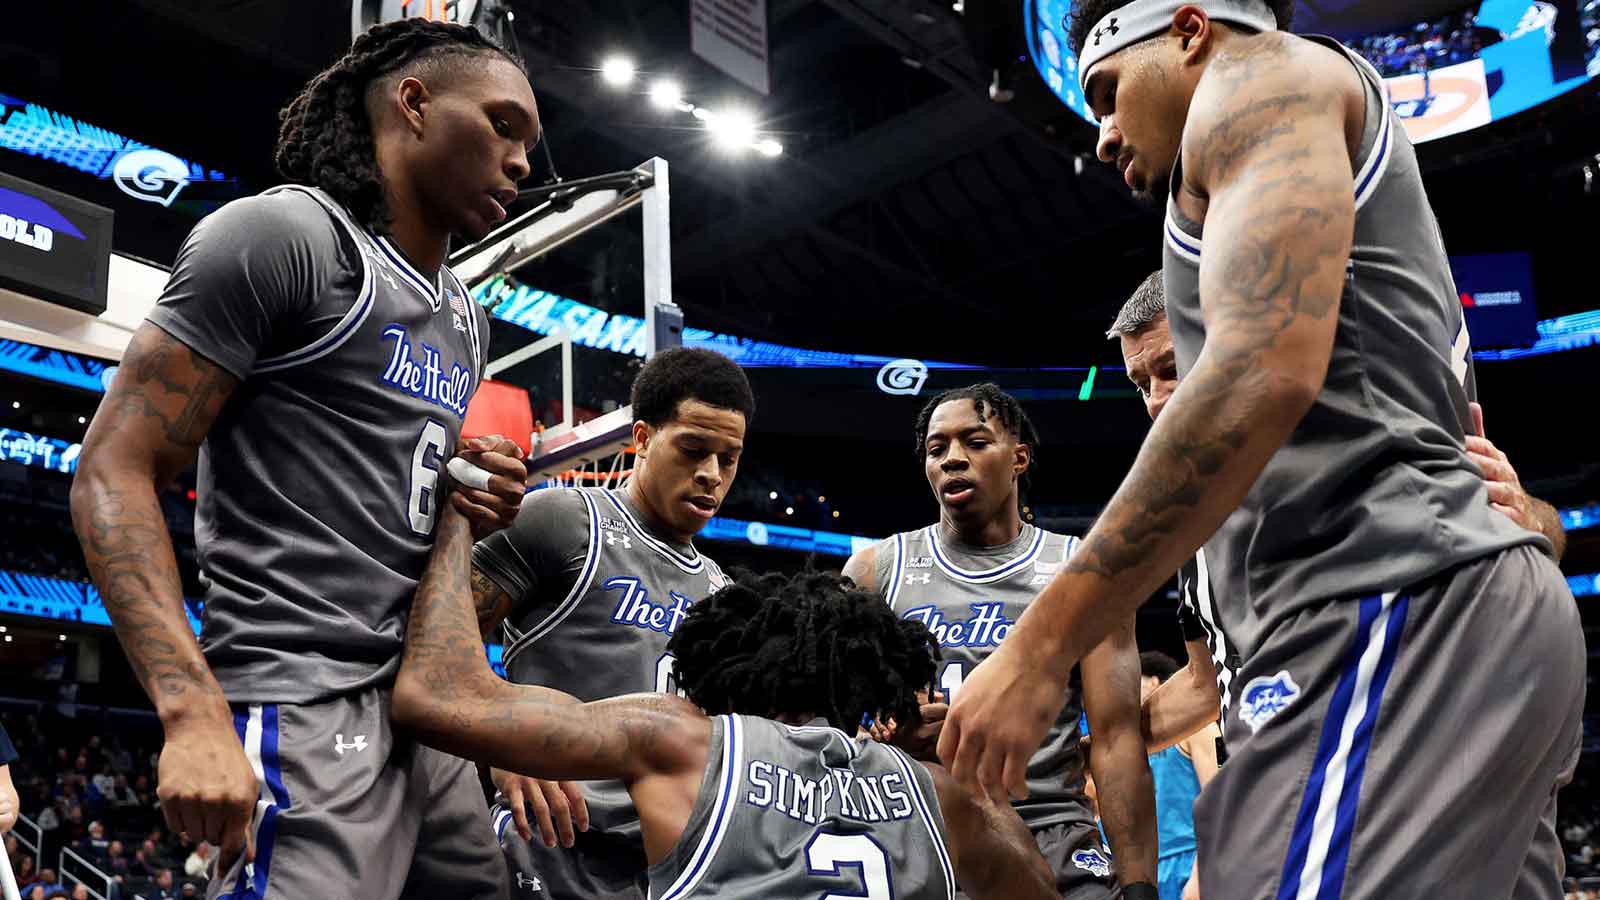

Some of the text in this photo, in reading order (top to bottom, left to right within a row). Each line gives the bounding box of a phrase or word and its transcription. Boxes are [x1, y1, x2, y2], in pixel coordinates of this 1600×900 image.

[0, 213, 54, 252] OLD
[382, 324, 472, 418] The Hall
[408, 417, 447, 536] 6
[604, 576, 667, 632] The
[966, 602, 1017, 647] Ha
[748, 759, 914, 825] SIMPKNS
[804, 828, 895, 900] 2
